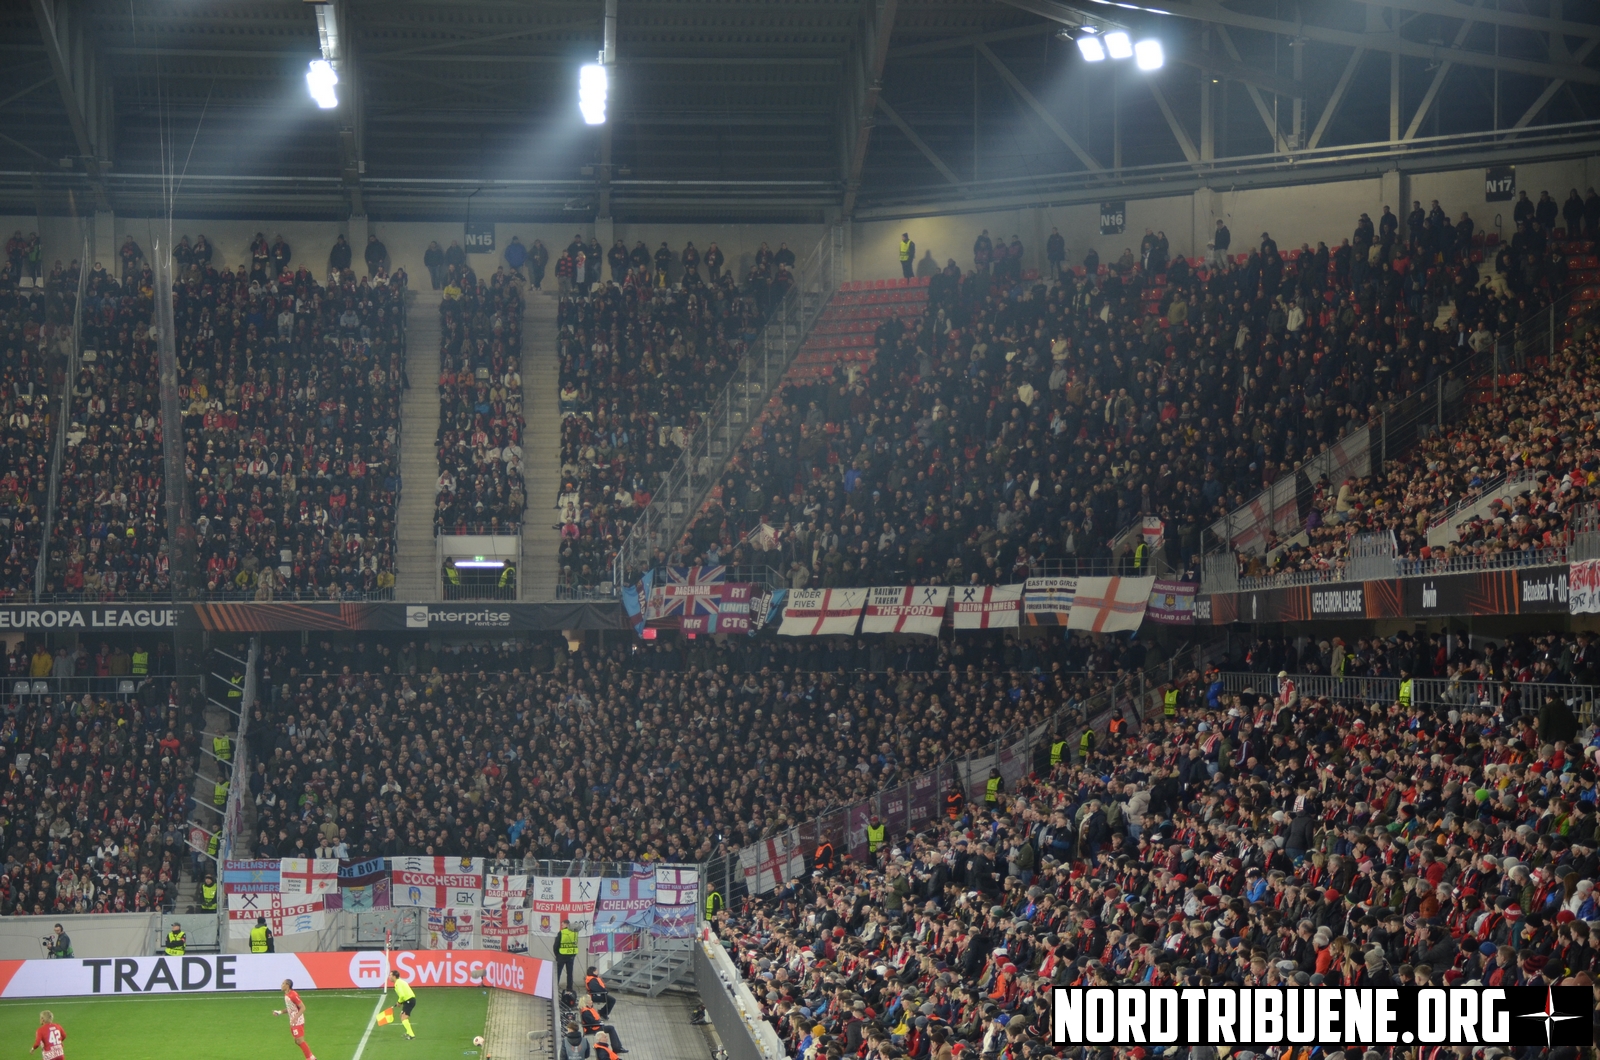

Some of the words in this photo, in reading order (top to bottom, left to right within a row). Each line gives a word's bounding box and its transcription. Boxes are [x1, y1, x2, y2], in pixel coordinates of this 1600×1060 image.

[1486, 180, 1512, 192] N17
[1100, 214, 1123, 226] N16
[465, 234, 492, 246] N15
[674, 586, 710, 595] DAGENHAM
[731, 588, 746, 598] RT
[959, 602, 982, 611] BOLTON
[984, 602, 1016, 611] HAMMERS
[1312, 592, 1324, 613] UEFA
[1324, 591, 1342, 612] EUROPA
[1342, 590, 1362, 612] LEAGUE
[408, 610, 511, 624] enterprise
[877, 606, 934, 616] THETFORD
[0, 610, 86, 628] EUROPA
[92, 610, 178, 627] LEAGUE
[358, 860, 378, 875] BOY
[402, 873, 476, 887] COLCHESTER
[237, 904, 313, 919] FAMBRIDGE
[536, 903, 554, 911] WEST
[602, 900, 655, 910] CHELMSFO
[272, 893, 282, 934] NORTH
[82, 956, 237, 993] TRADE
[396, 951, 525, 990] Swissquote
[49, 1030, 61, 1045] 42
